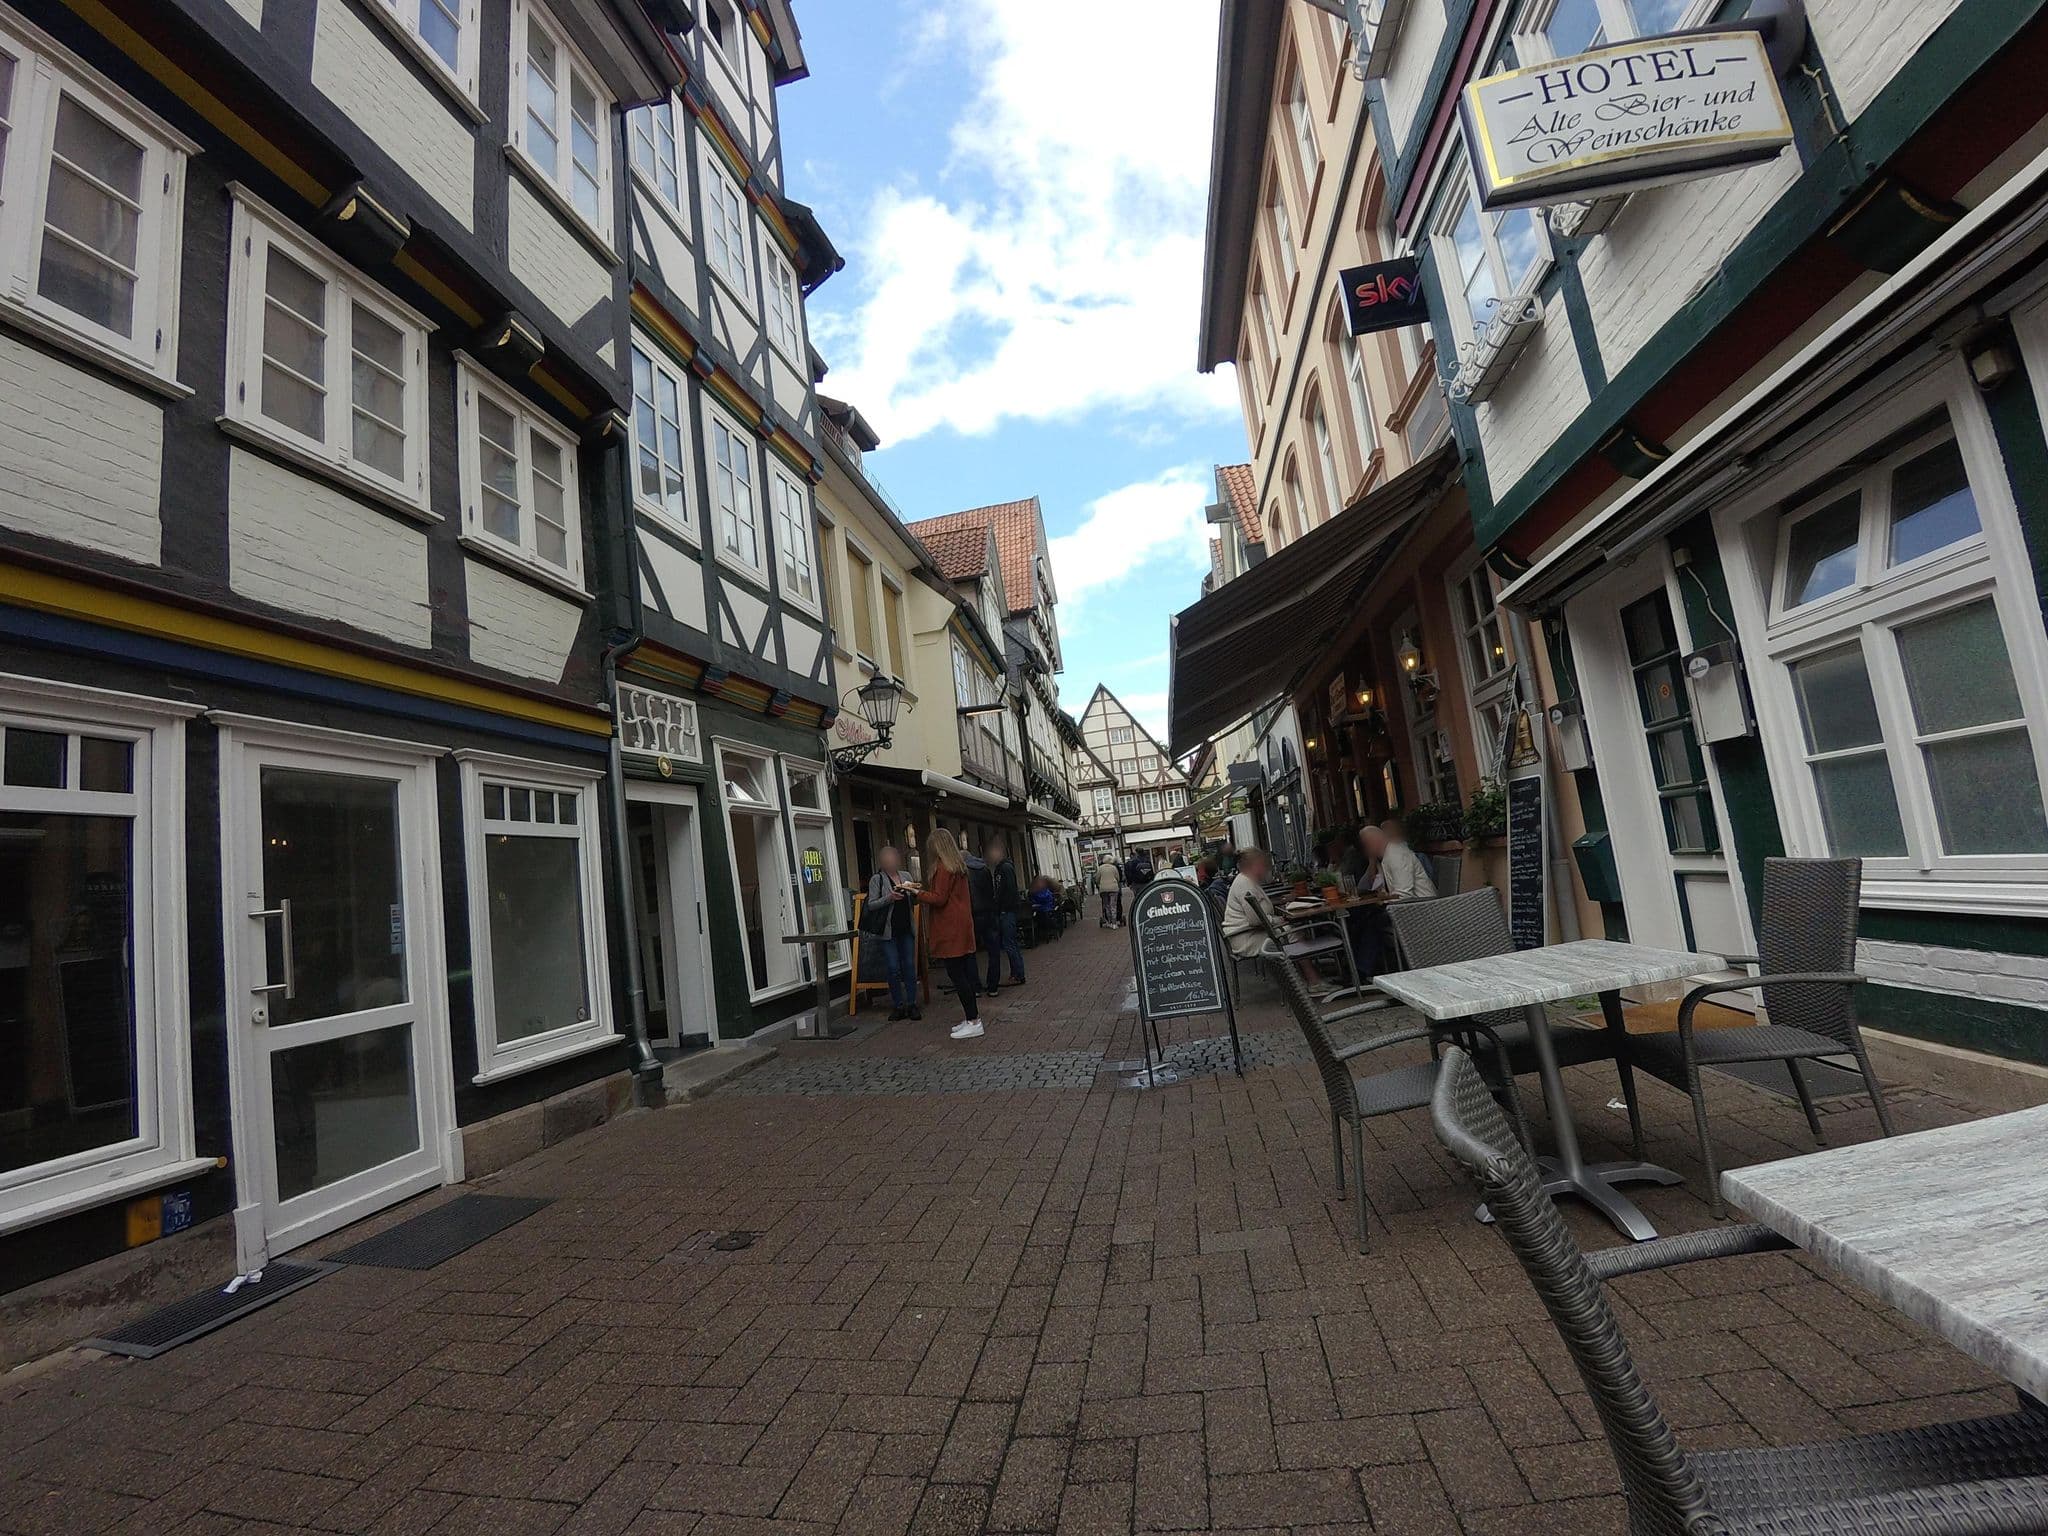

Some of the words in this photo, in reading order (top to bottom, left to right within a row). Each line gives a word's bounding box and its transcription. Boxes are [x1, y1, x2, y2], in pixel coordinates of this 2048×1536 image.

[1535, 47, 1717, 105] HOTEL
[1507, 110, 1582, 146] Alte
[1594, 92, 1696, 122] Bier-
[1703, 81, 1756, 107] und
[1526, 111, 1742, 164] Weinschänke
[1355, 273, 1421, 308] sky
[803, 850, 823, 866] BUBBLE
[811, 868, 823, 883] TEA
